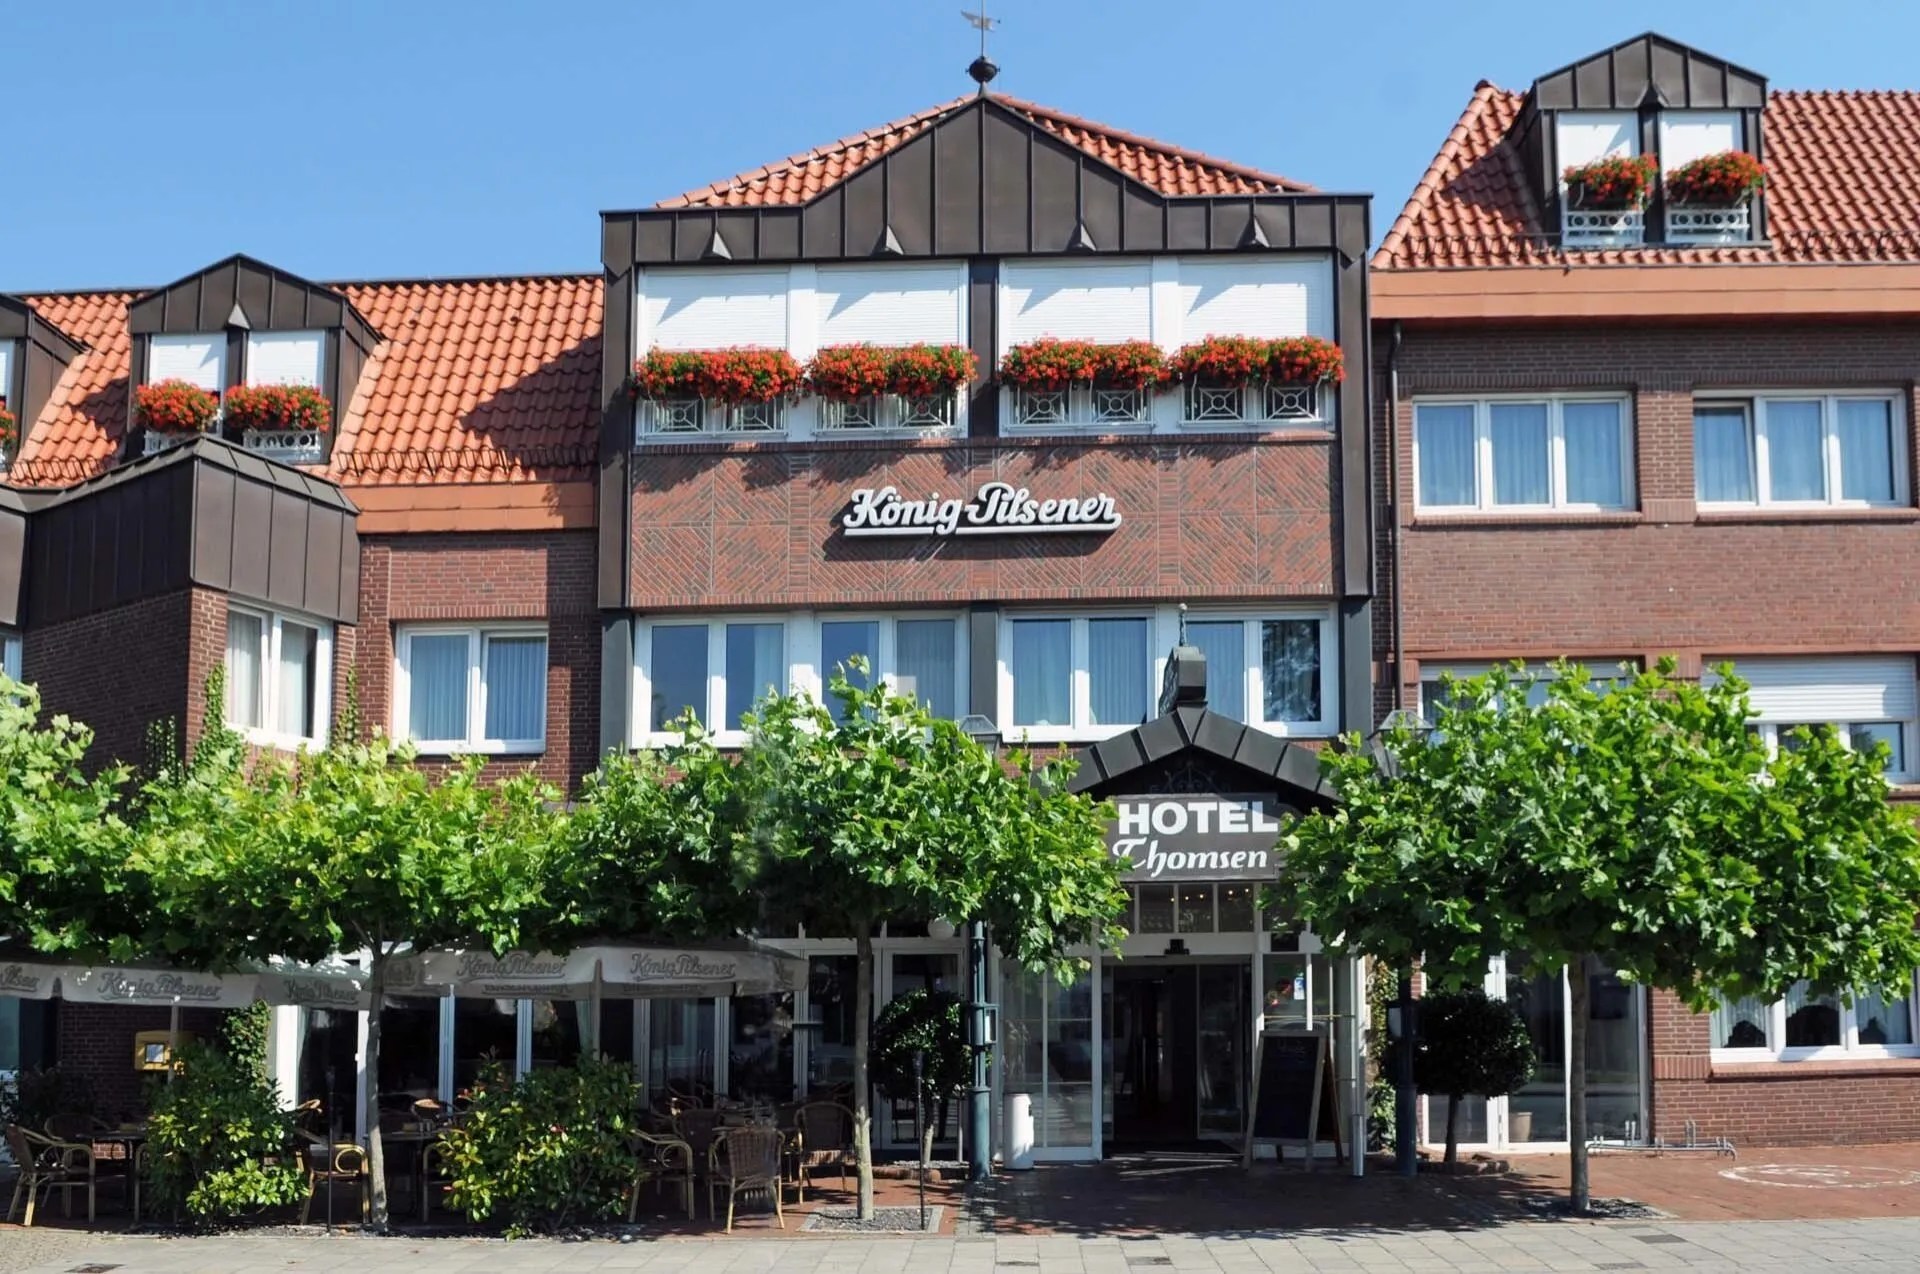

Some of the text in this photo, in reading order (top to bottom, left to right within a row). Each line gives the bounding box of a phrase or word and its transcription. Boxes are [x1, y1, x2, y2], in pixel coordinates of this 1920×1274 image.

[843, 482, 1122, 535] König Pilsener
[1118, 801, 1278, 835] HOTEL
[1112, 836, 1267, 878] Thomsen
